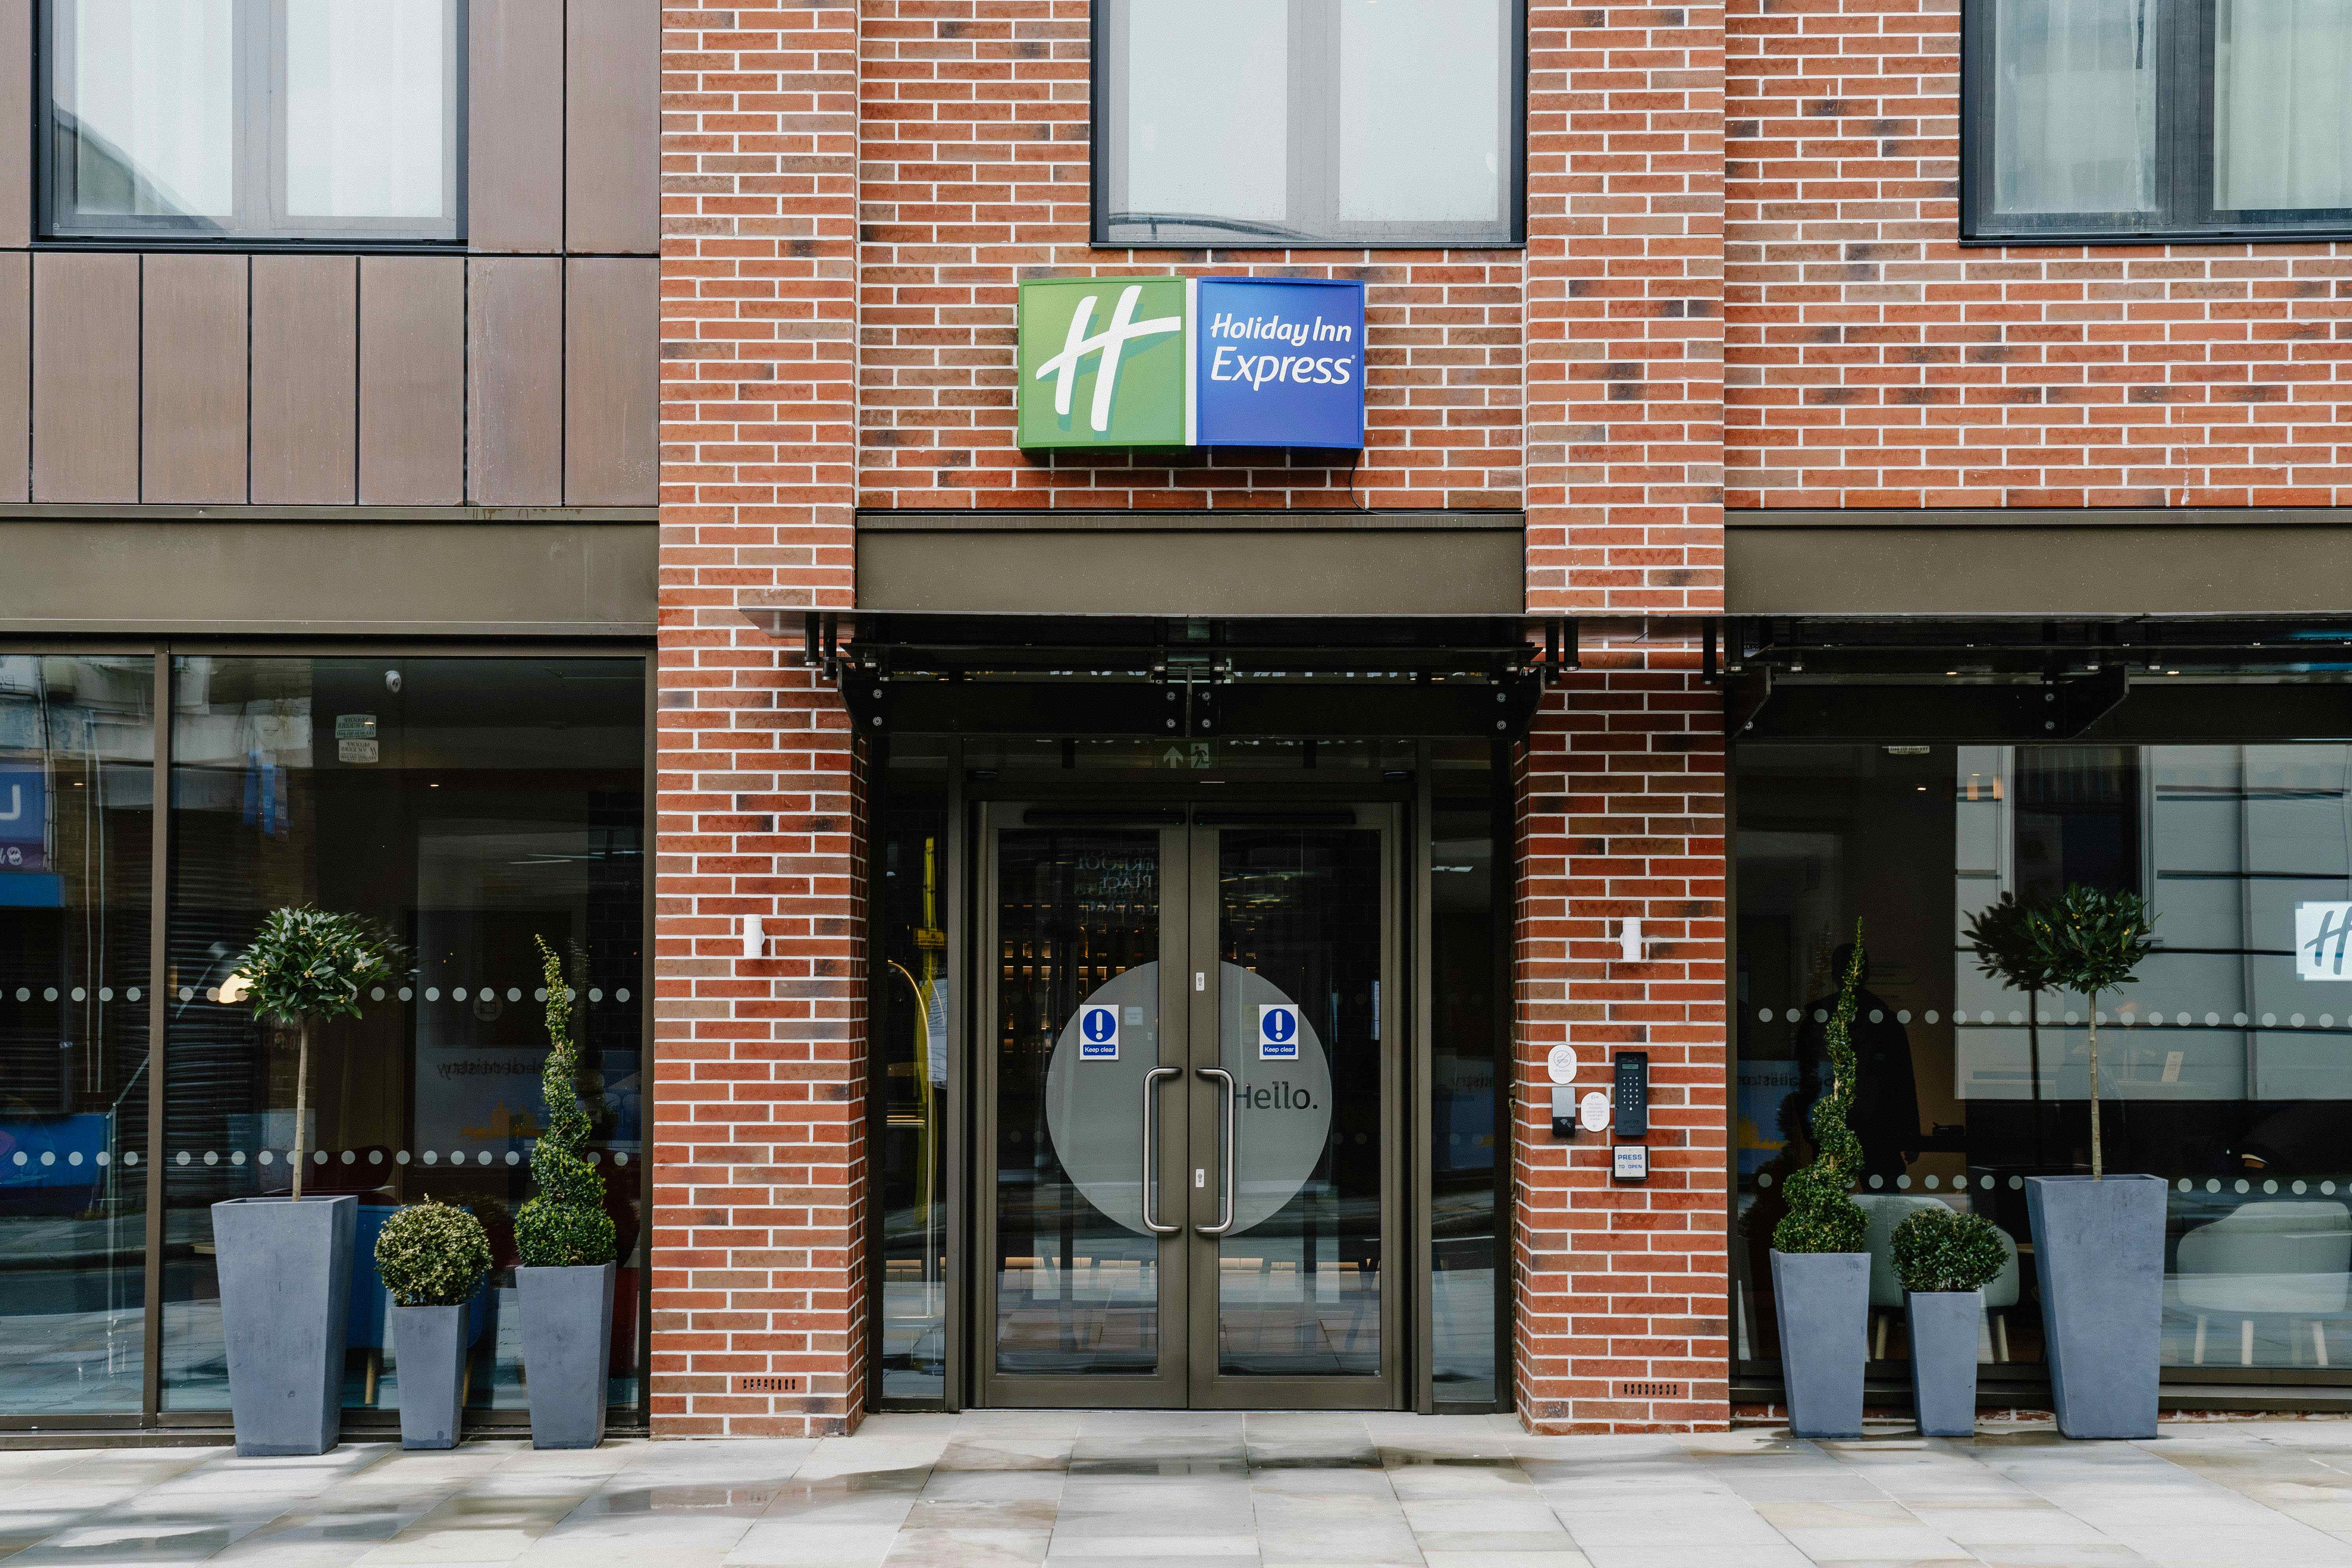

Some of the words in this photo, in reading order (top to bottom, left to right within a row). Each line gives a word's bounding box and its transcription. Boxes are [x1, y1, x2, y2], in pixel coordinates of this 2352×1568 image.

[1210, 313, 1310, 347] Holiday
[1312, 316, 1352, 342] Inn
[1234, 1081, 1318, 1109] Hello.
